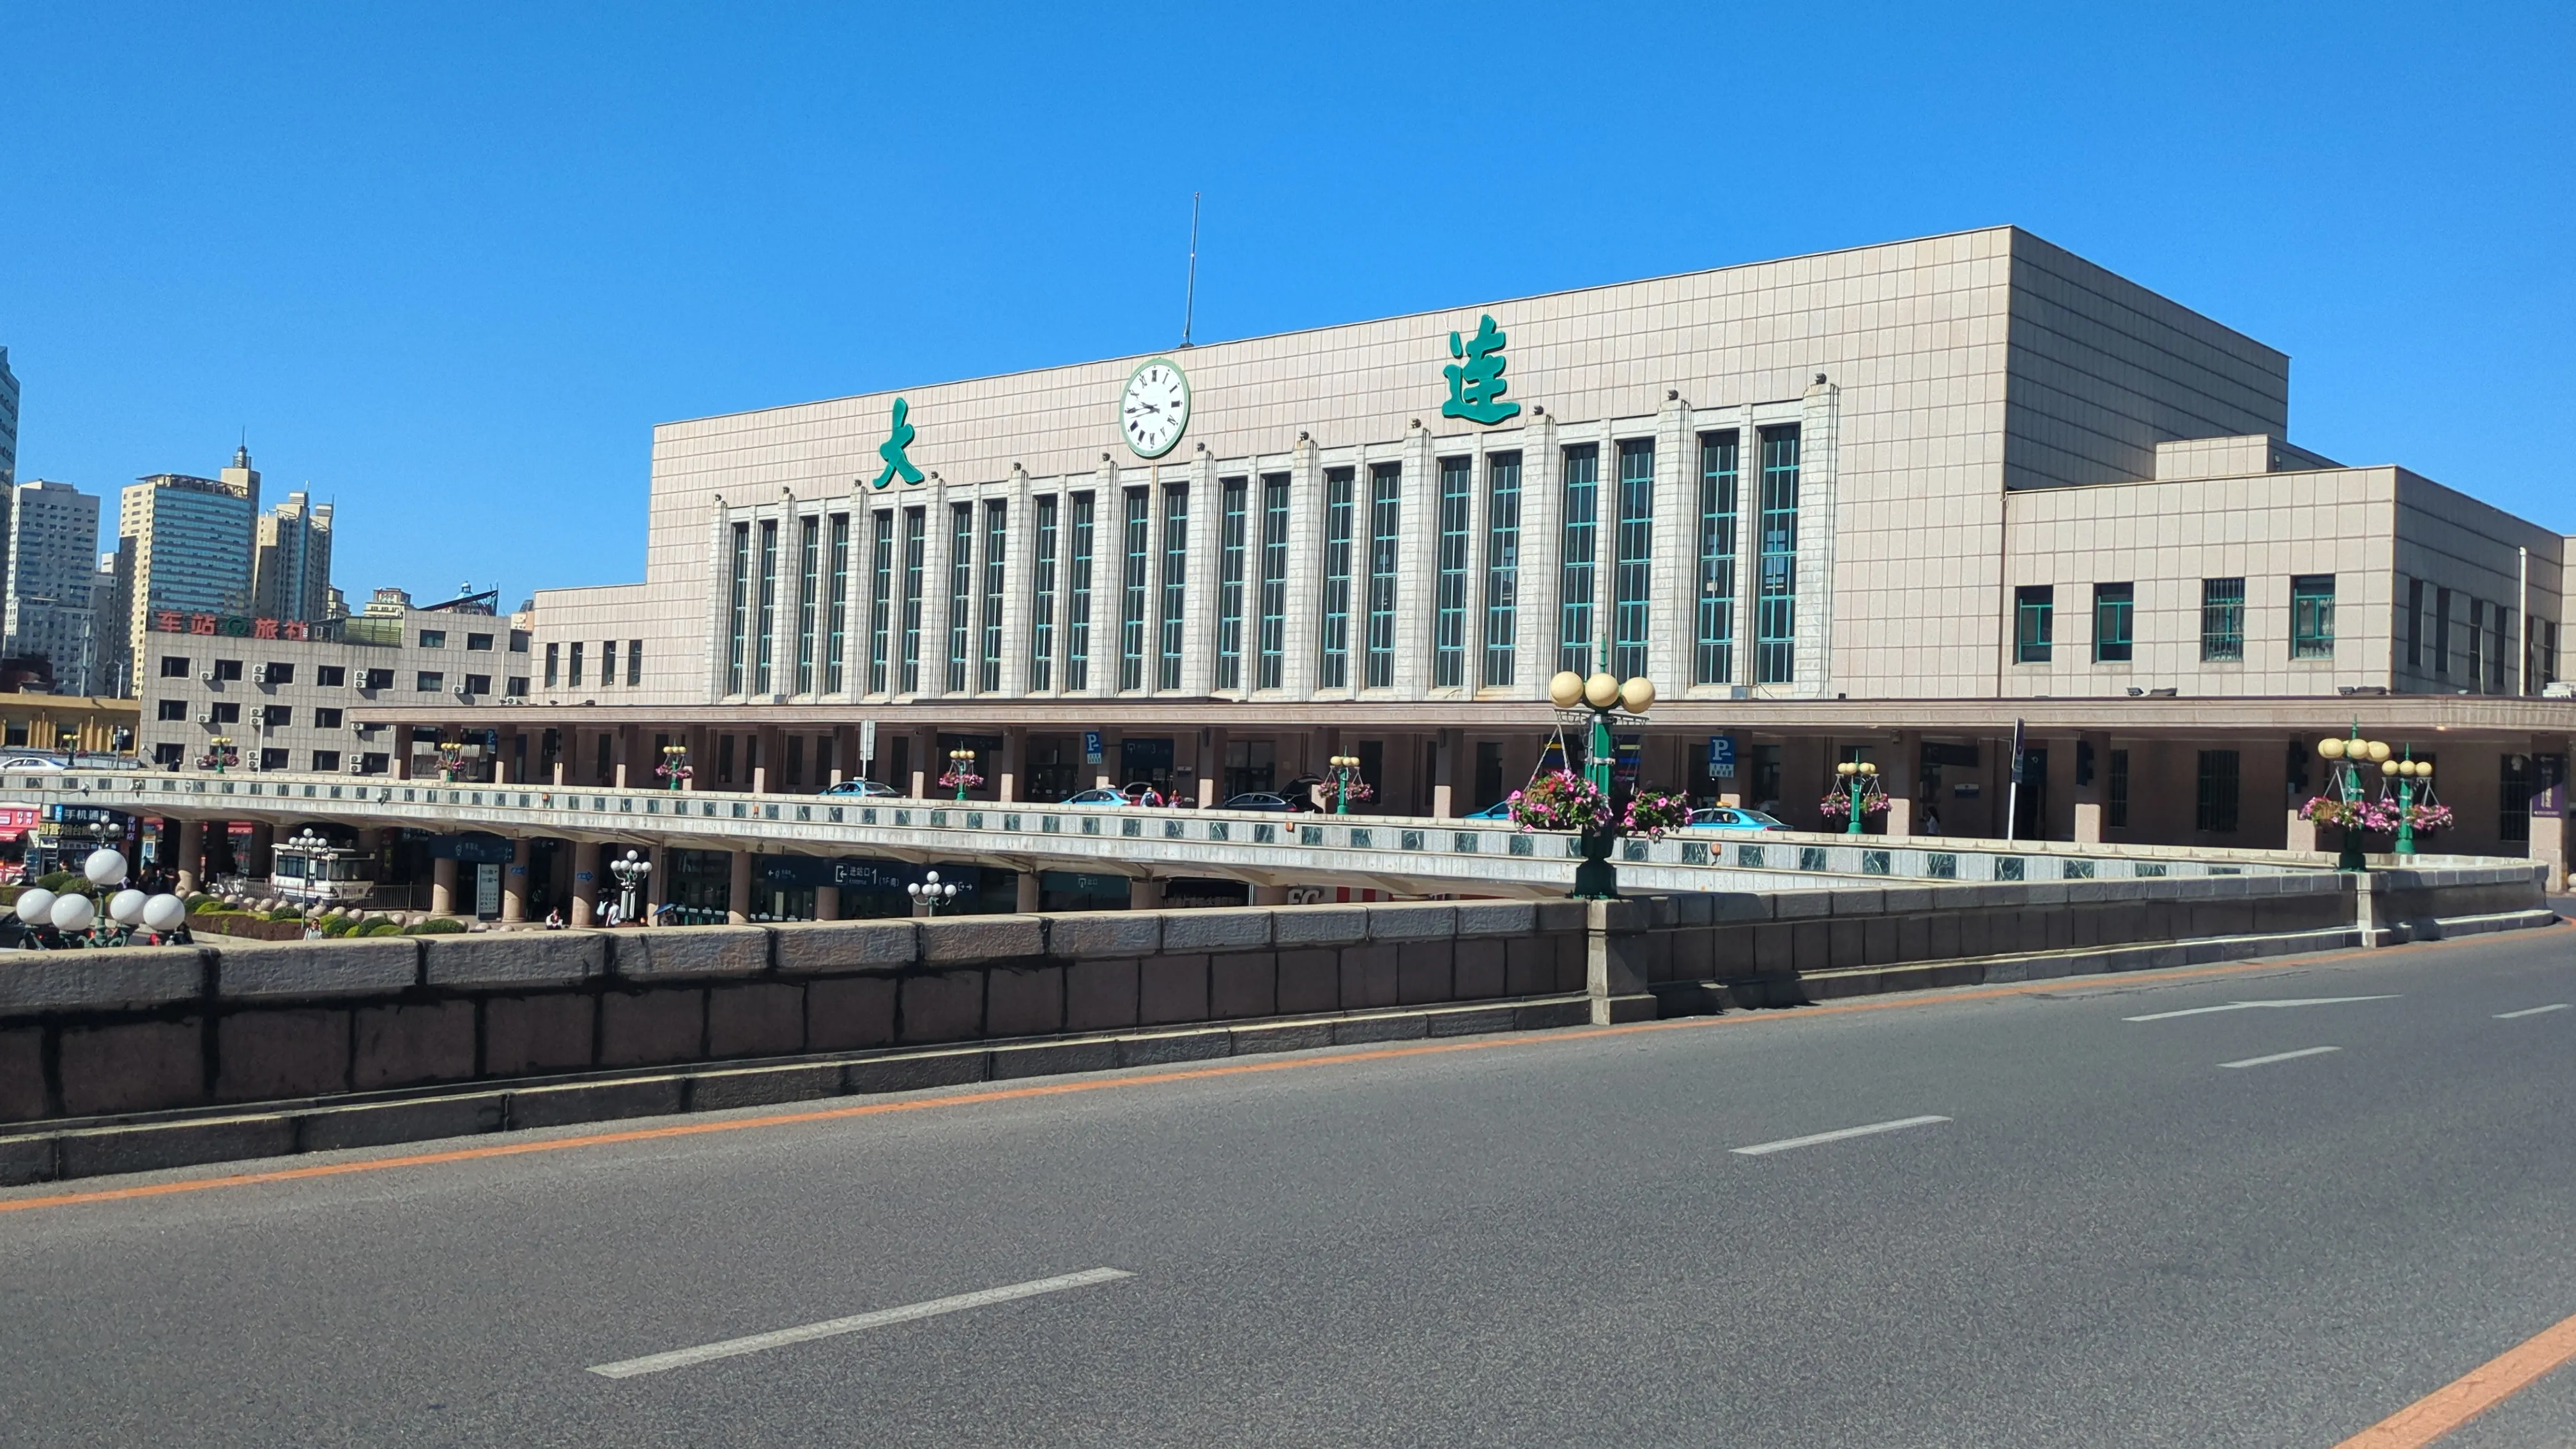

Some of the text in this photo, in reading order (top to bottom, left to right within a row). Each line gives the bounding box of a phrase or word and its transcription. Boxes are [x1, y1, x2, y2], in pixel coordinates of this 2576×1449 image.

[873, 314, 1521, 490] 大 连
[158, 611, 309, 641] 车站 旅社
[1087, 734, 1097, 751] P
[1712, 739, 1729, 760] P
[871, 868, 877, 885] 1
